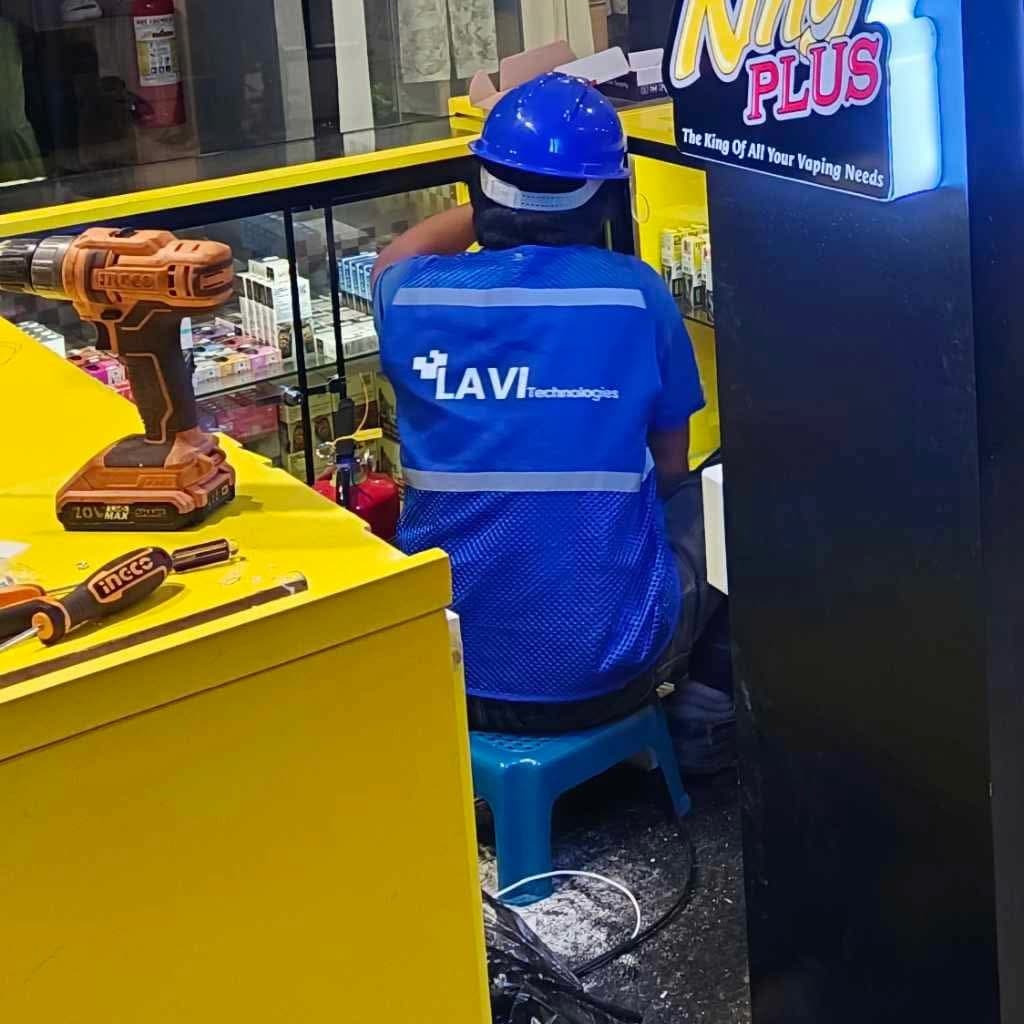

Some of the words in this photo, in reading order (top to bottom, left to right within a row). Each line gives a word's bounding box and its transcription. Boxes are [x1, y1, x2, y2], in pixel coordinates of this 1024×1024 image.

[746, 35, 882, 123] PLUS
[682, 128, 702, 146] The
[704, 133, 730, 155] King
[732, 139, 747, 160] Of
[748, 142, 765, 161] All
[767, 146, 795, 167] Your
[797, 153, 841, 182] Vaping
[844, 164, 885, 188] Needs
[435, 366, 529, 400] LAVI
[528, 386, 620, 402] Technologies
